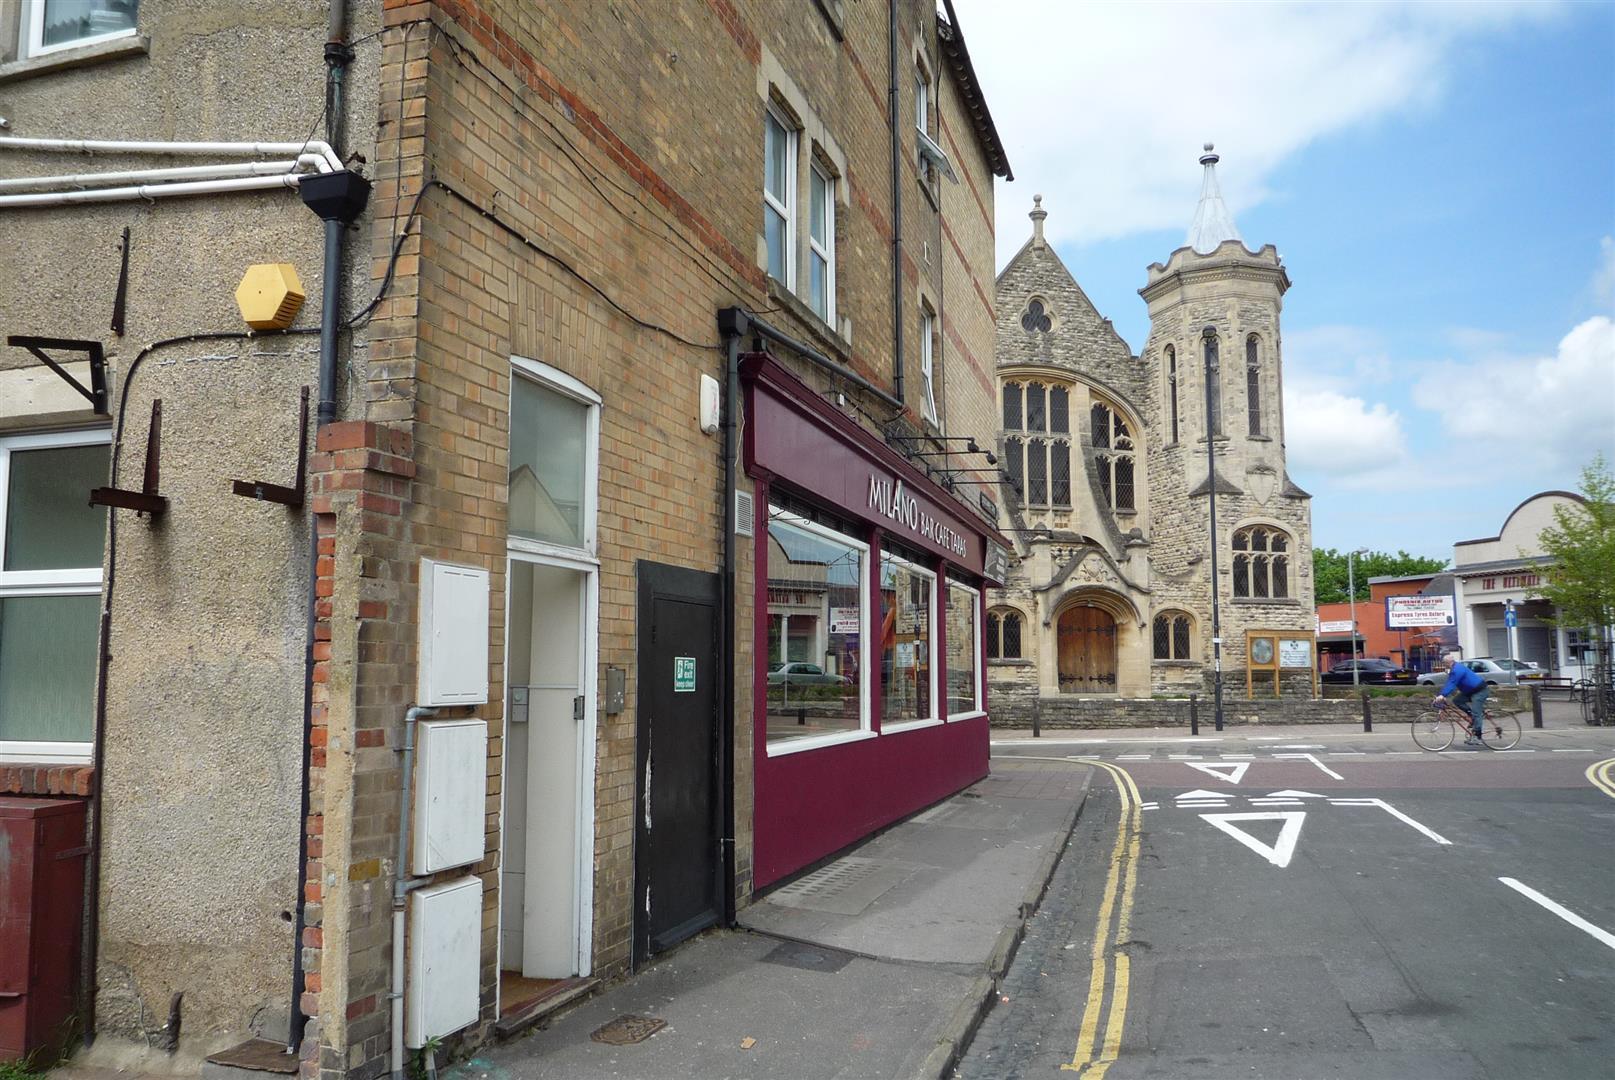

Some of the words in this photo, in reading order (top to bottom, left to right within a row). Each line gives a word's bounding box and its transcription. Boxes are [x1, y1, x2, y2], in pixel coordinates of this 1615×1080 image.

[869, 474, 918, 530] MILANO
[921, 512, 935, 541] BAR
[935, 522, 949, 549] CAFE
[950, 530, 966, 558] TAPAS
[684, 660, 694, 670] Fire
[684, 670, 693, 679] exit
